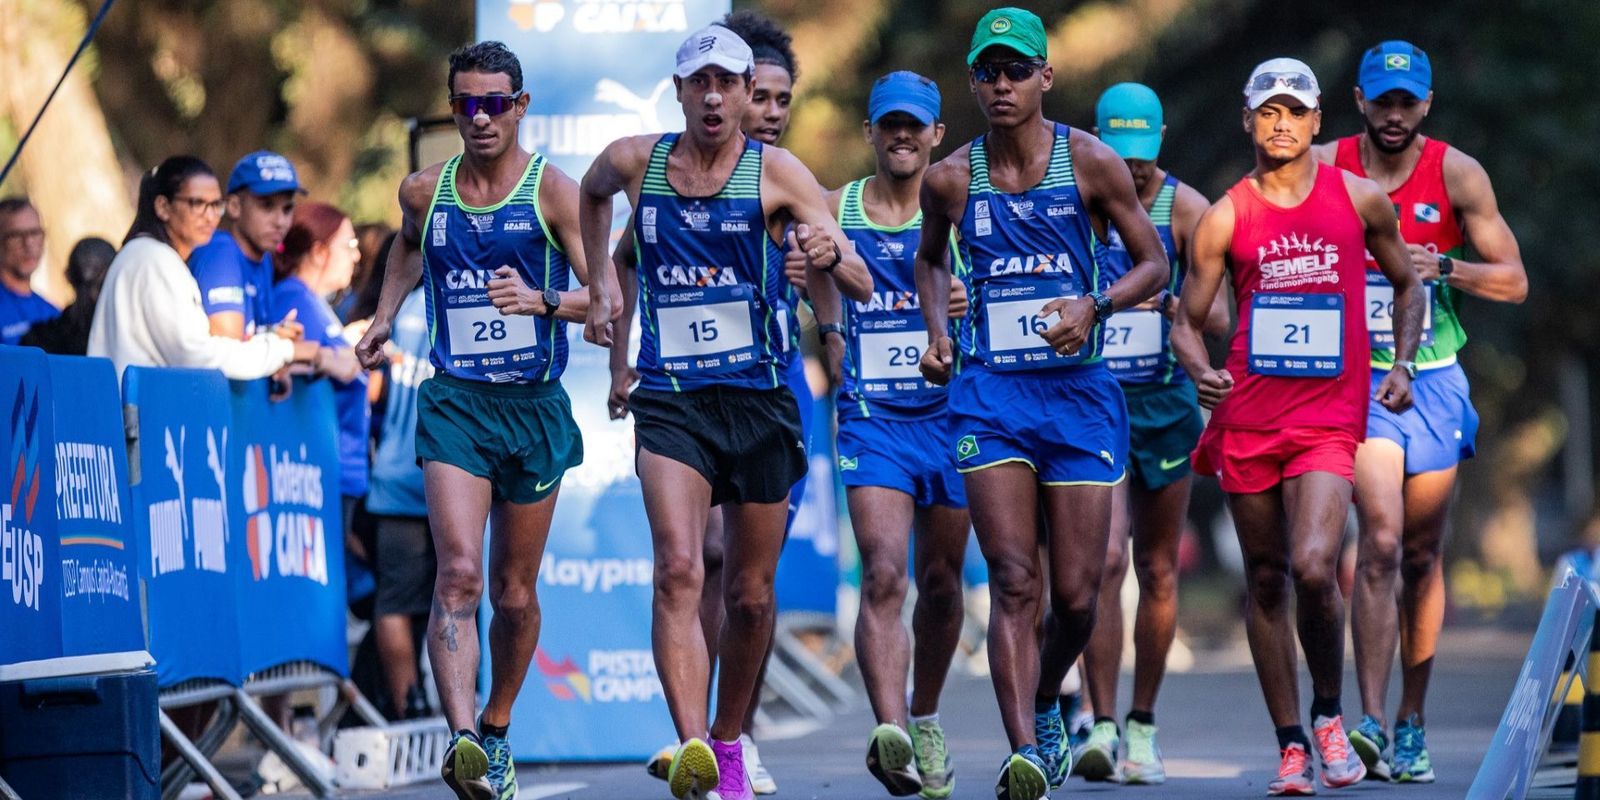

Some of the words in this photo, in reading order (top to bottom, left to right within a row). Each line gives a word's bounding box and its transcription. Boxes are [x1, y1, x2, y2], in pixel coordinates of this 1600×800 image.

[573, 3, 688, 33] CAIXA
[1109, 119, 1150, 129] BRASIL
[1047, 206, 1077, 216] BRASIL
[504, 222, 532, 231] BRASIL
[721, 223, 750, 231] BRASIL
[657, 265, 738, 287] CAIXA
[989, 253, 1073, 276] CAIXA
[1260, 253, 1339, 279] SEMELP
[472, 319, 507, 342] 28
[689, 319, 719, 343] 15
[1018, 314, 1048, 337] 16
[1105, 327, 1132, 345] 27
[1284, 324, 1310, 344] 21
[888, 346, 920, 367] 29
[55, 442, 121, 524] PREFEITURA
[270, 443, 323, 511] loterias
[149, 498, 185, 578] PUMA
[192, 497, 227, 574] PUMA
[0, 503, 44, 612] EUSP
[276, 512, 328, 586] CAIXA
[539, 551, 653, 593] laypis
[594, 677, 668, 702] CAMP
